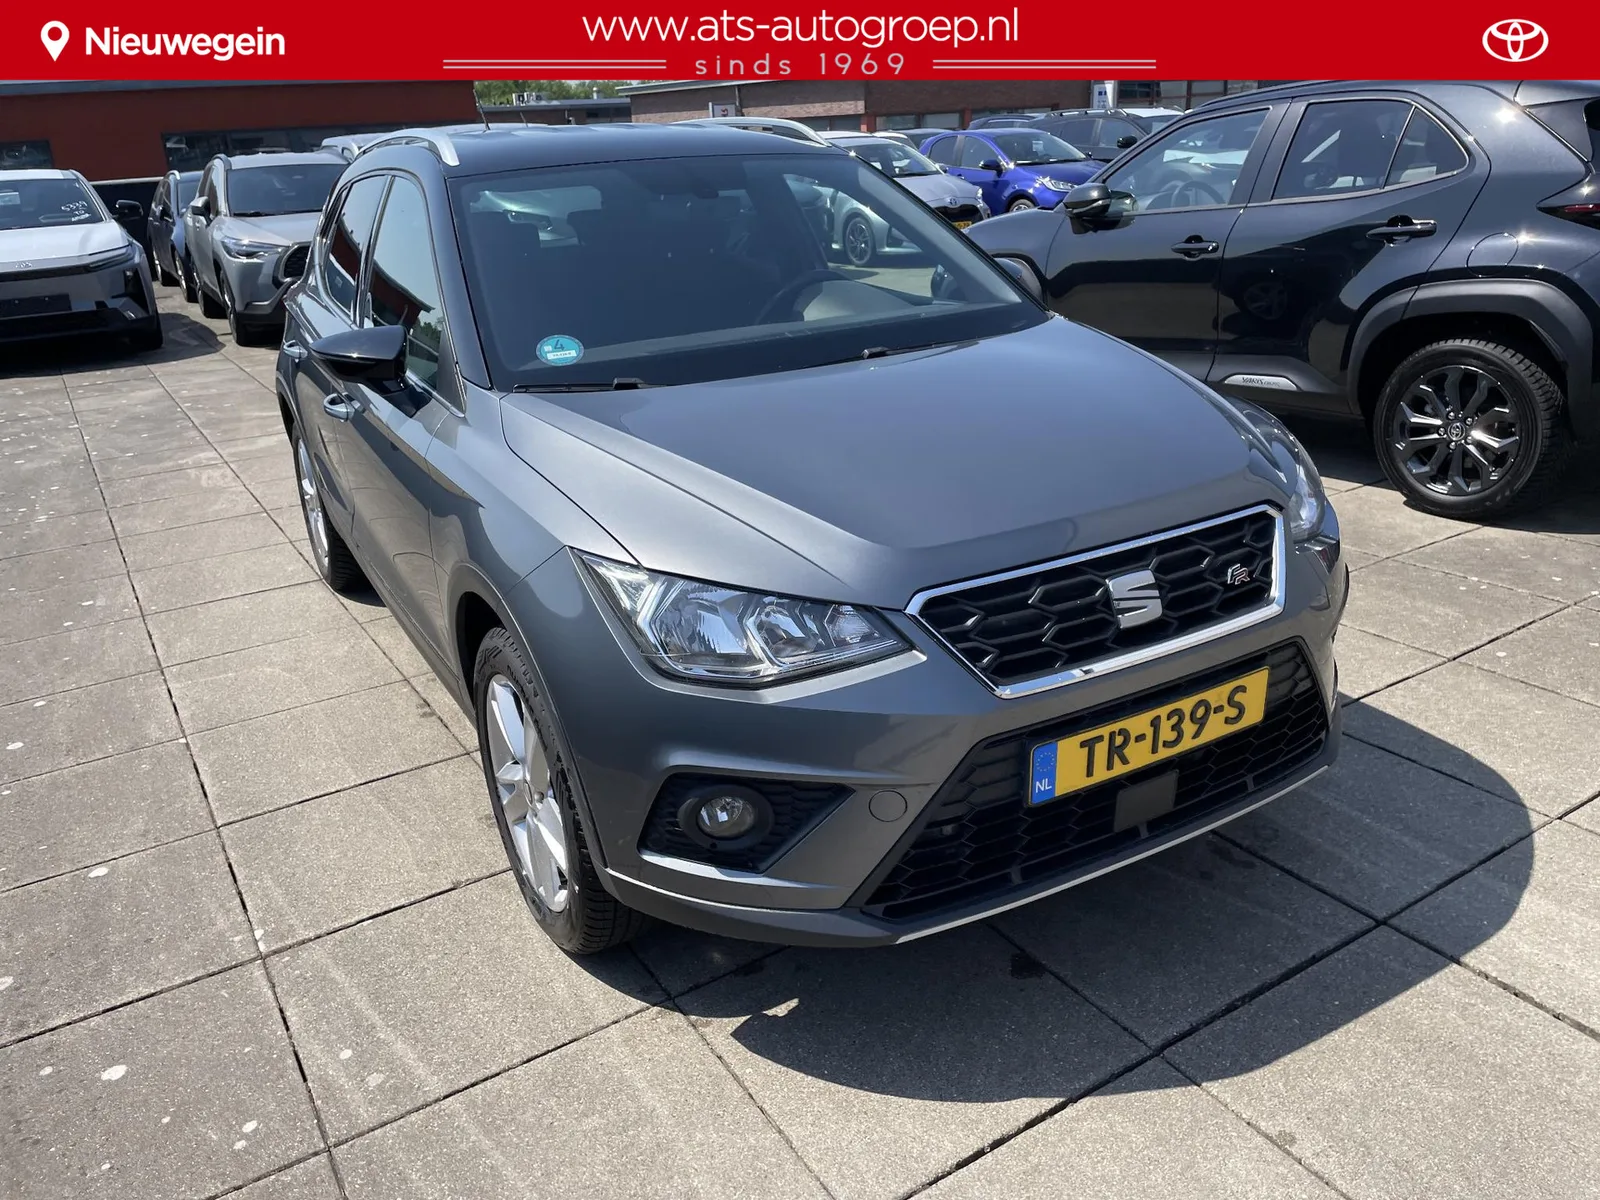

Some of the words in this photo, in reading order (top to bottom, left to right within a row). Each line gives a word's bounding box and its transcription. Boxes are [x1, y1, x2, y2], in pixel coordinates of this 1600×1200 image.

[554, 339, 565, 351] 4
[1227, 563, 1250, 585] FR
[1079, 684, 1248, 778] TR-139-S
[1035, 777, 1052, 794] NL
